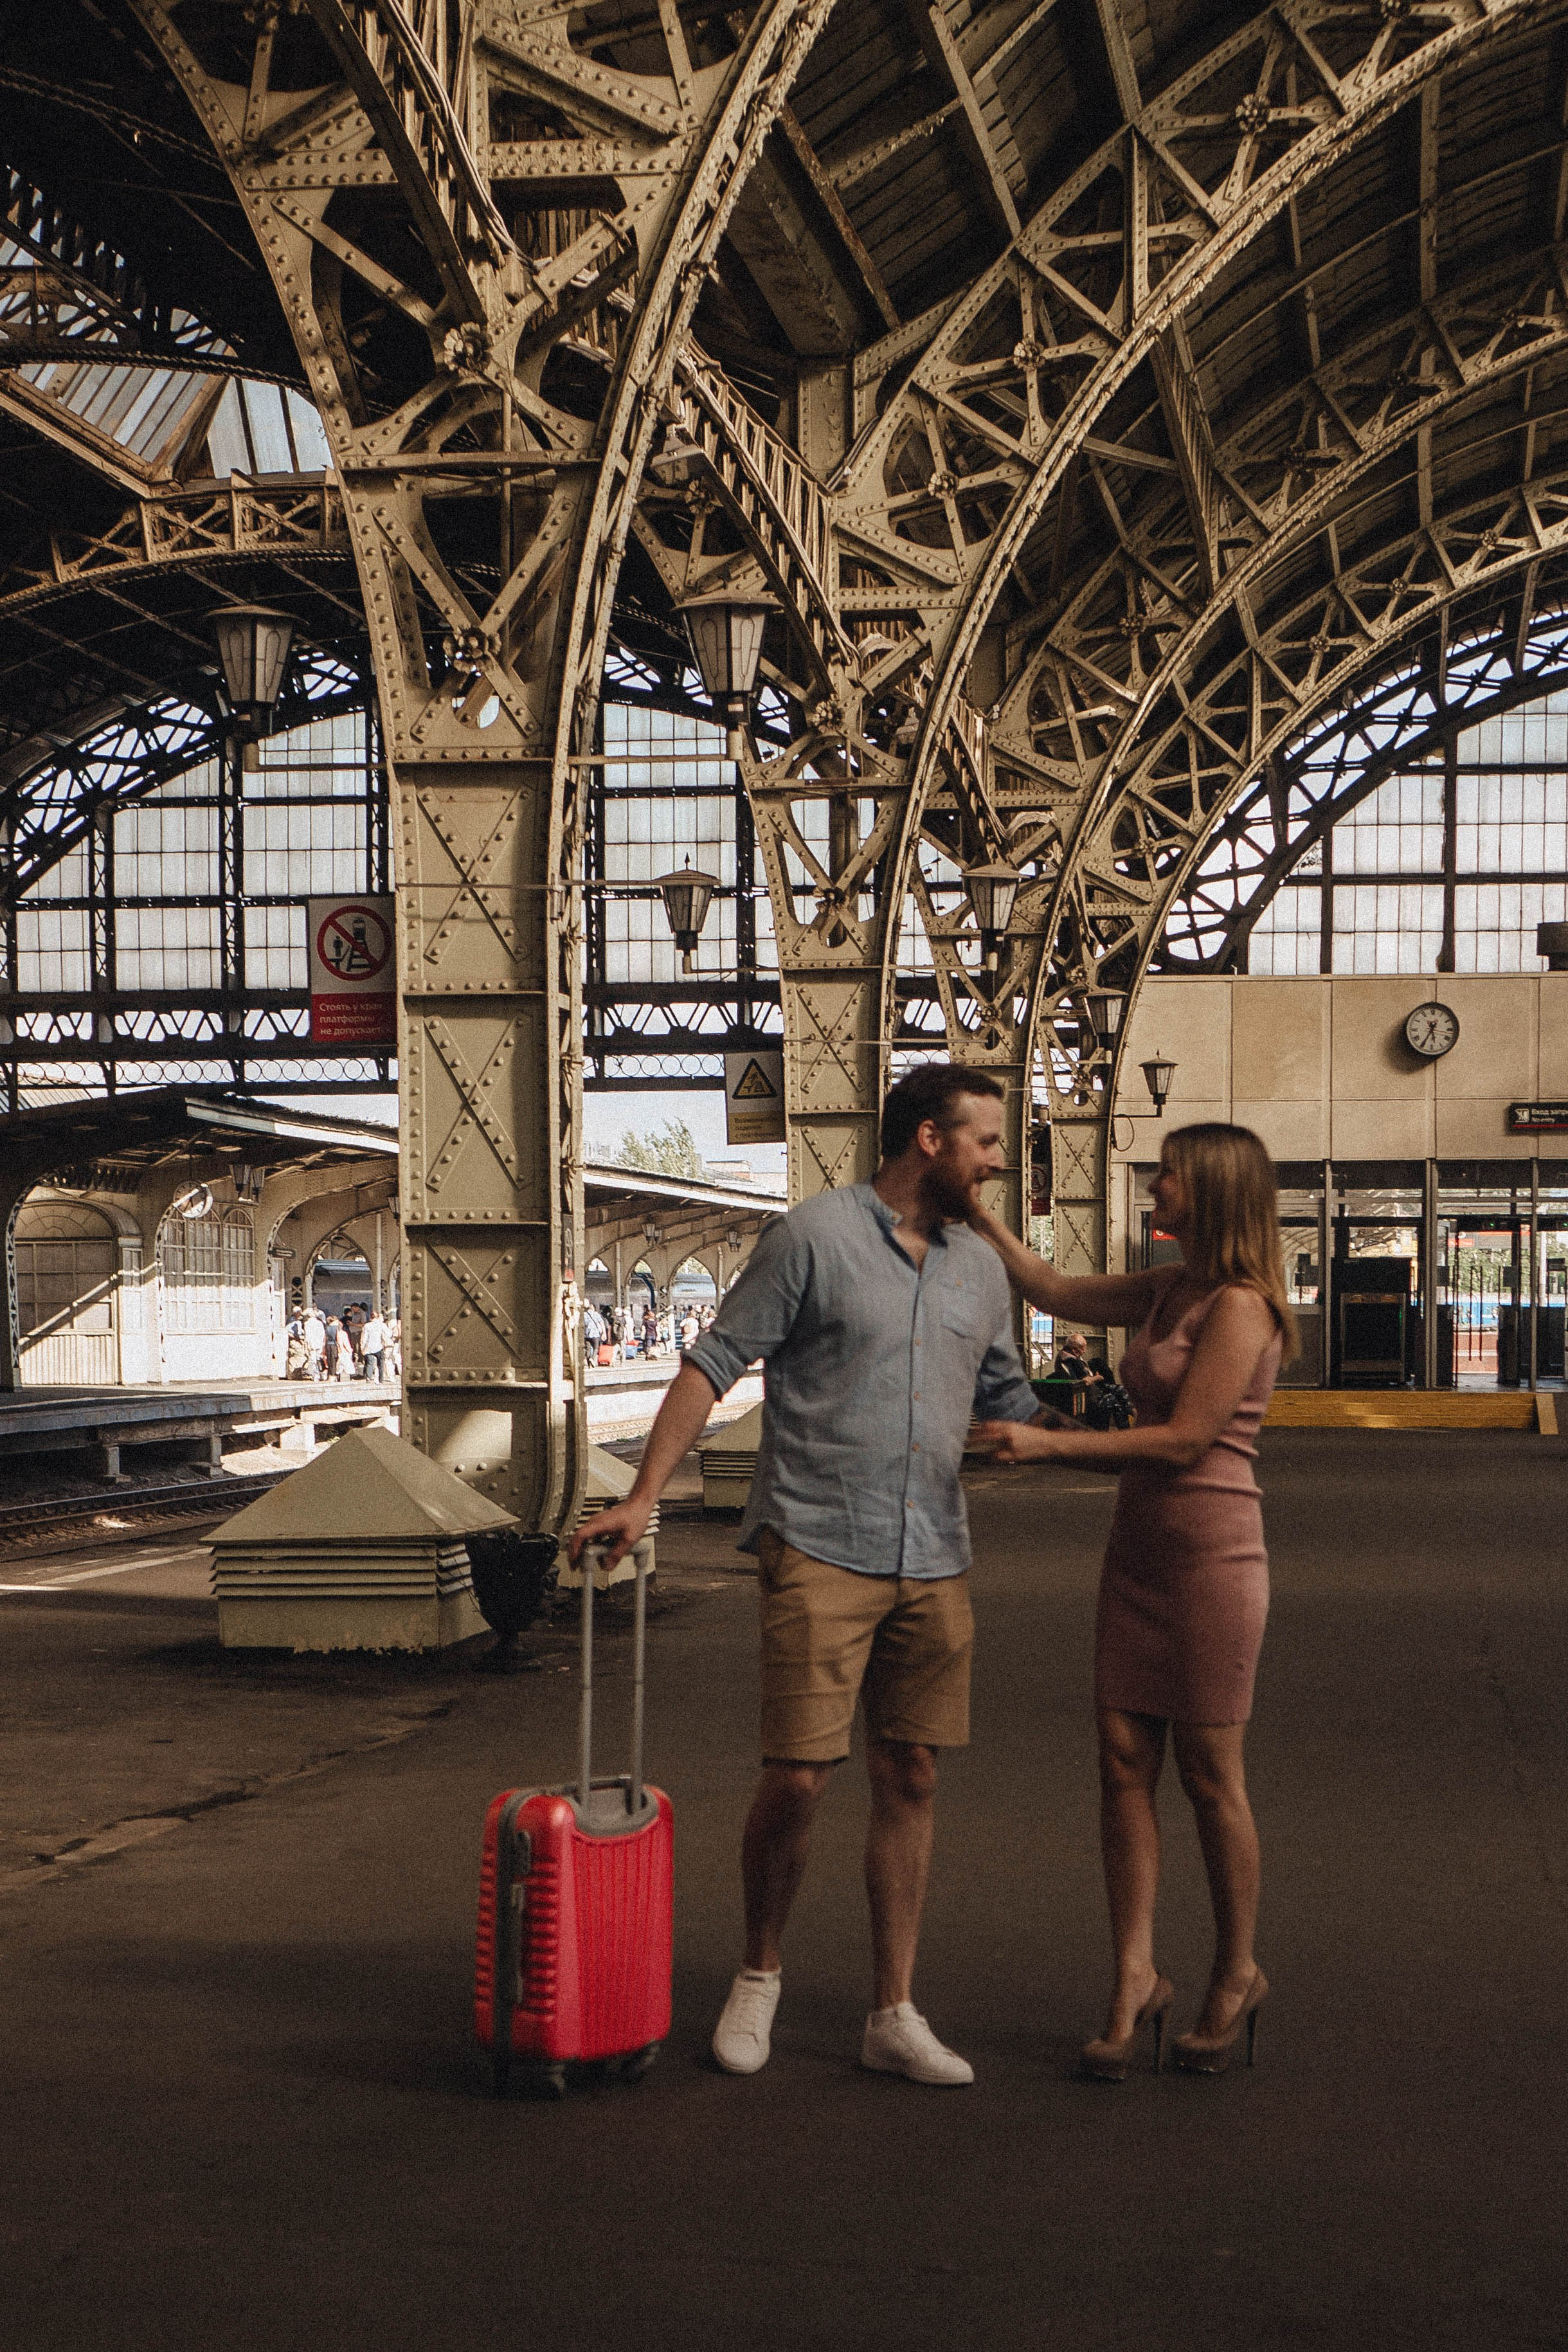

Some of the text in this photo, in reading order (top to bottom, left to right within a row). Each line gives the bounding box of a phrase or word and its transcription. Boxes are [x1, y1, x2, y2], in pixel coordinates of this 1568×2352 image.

[320, 1003, 351, 1011] Стоять
[352, 1004, 358, 1013] у
[320, 1015, 375, 1024] платформы
[333, 1026, 391, 1036] допускает
